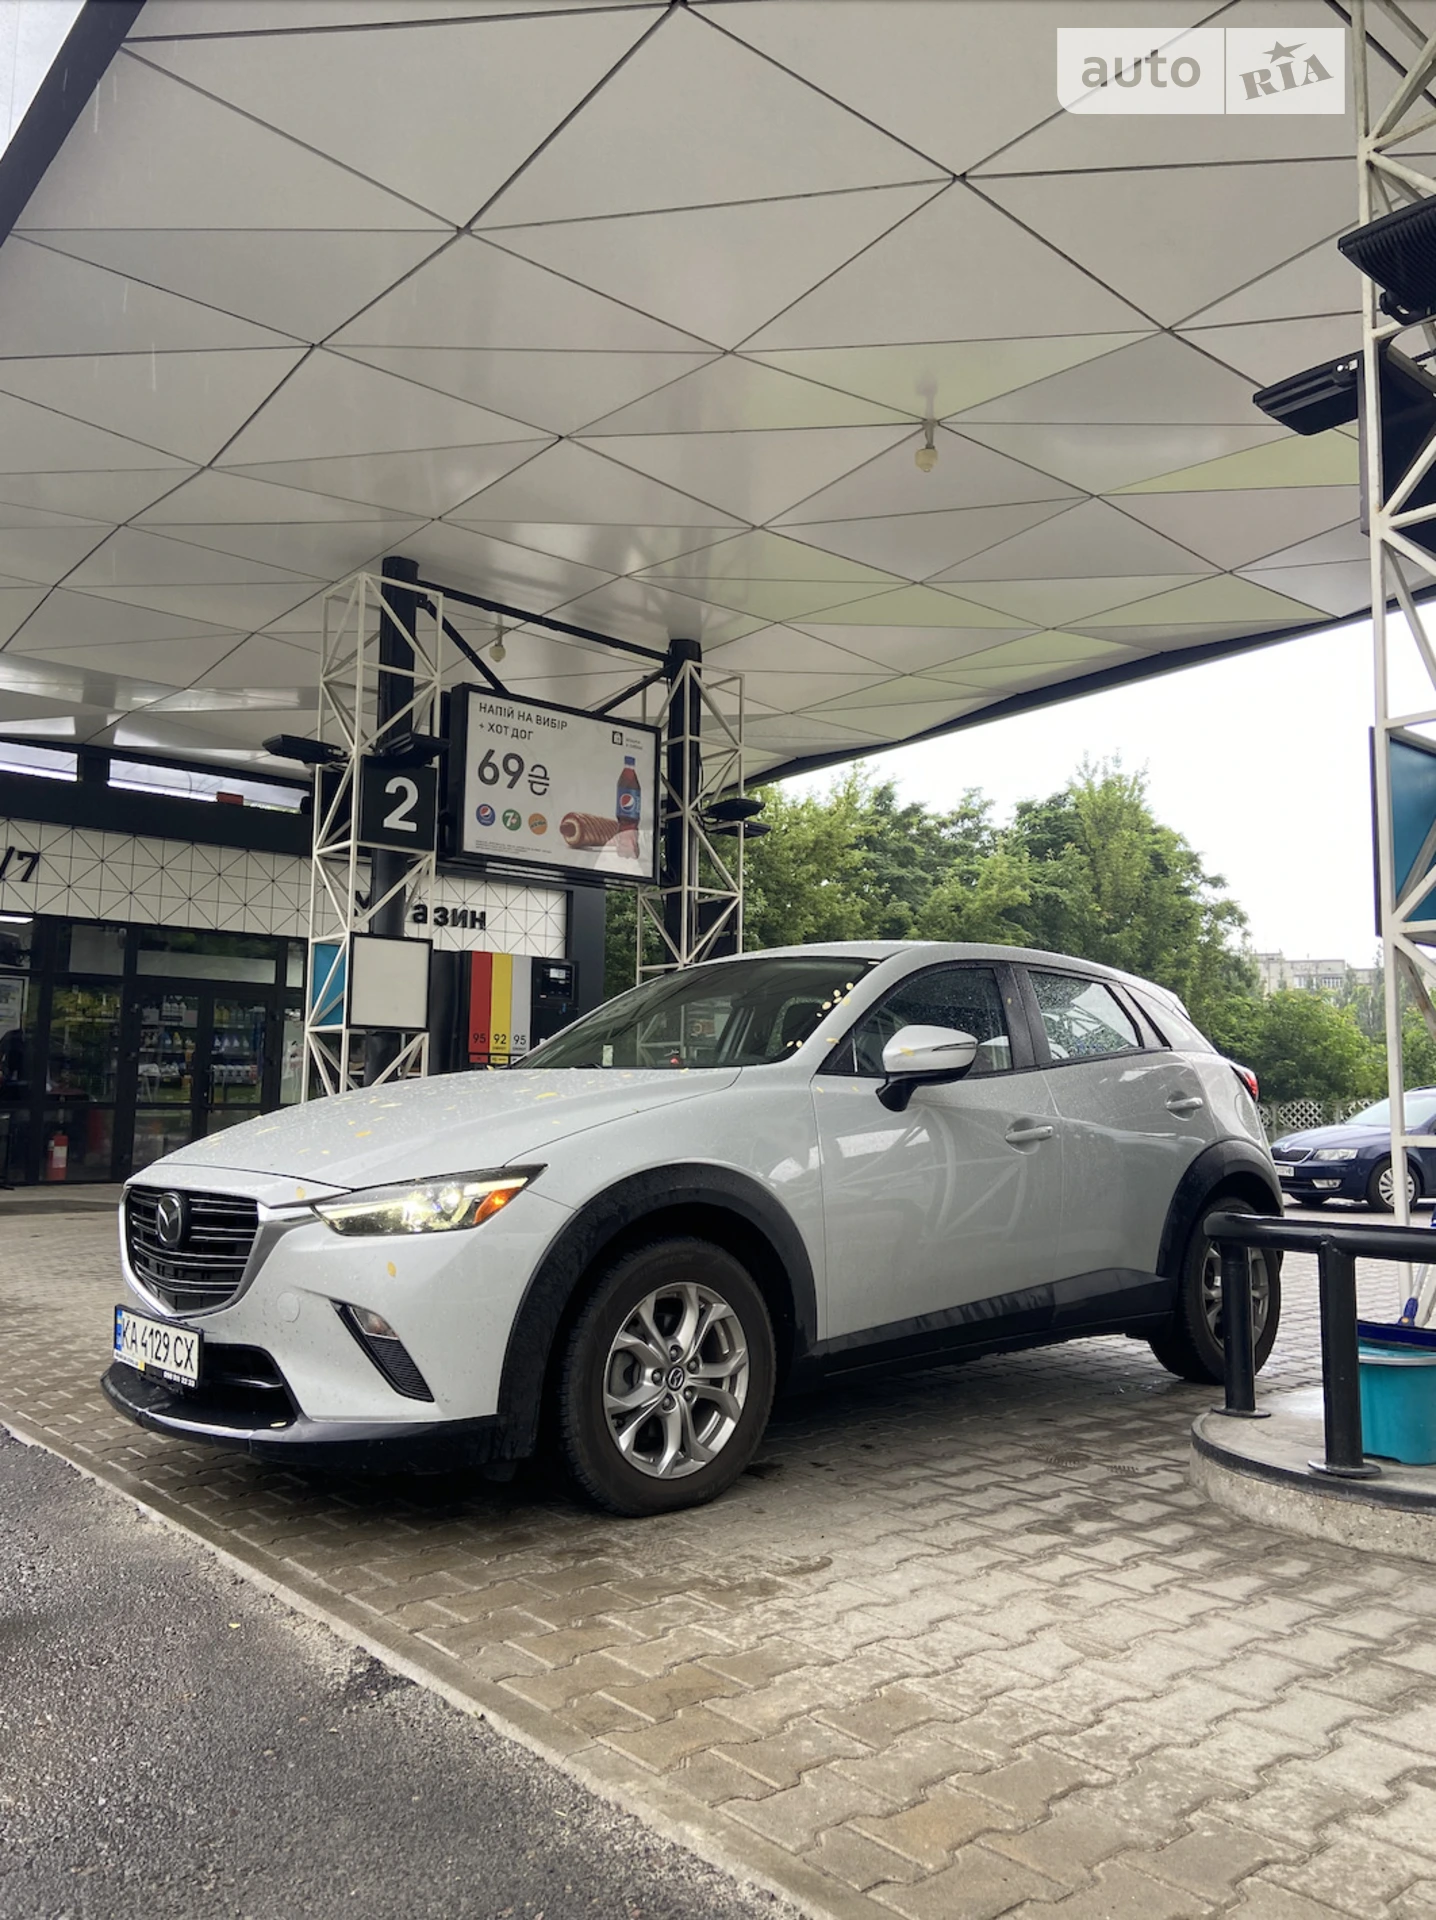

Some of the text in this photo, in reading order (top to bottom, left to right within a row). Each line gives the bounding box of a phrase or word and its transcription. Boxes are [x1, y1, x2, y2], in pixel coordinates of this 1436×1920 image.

[479, 702, 568, 731] НАПІЙ НА ВИБІР
[487, 721, 509, 736] ХОТ
[510, 726, 534, 741] ДОГ
[383, 776, 419, 832] 2
[472, 1032, 487, 1044] 95
[493, 1033, 507, 1045] 92
[513, 1034, 527, 1046] 95
[122, 1316, 138, 1353] KA
[141, 1325, 170, 1363] 4129
[173, 1335, 194, 1372] CX
